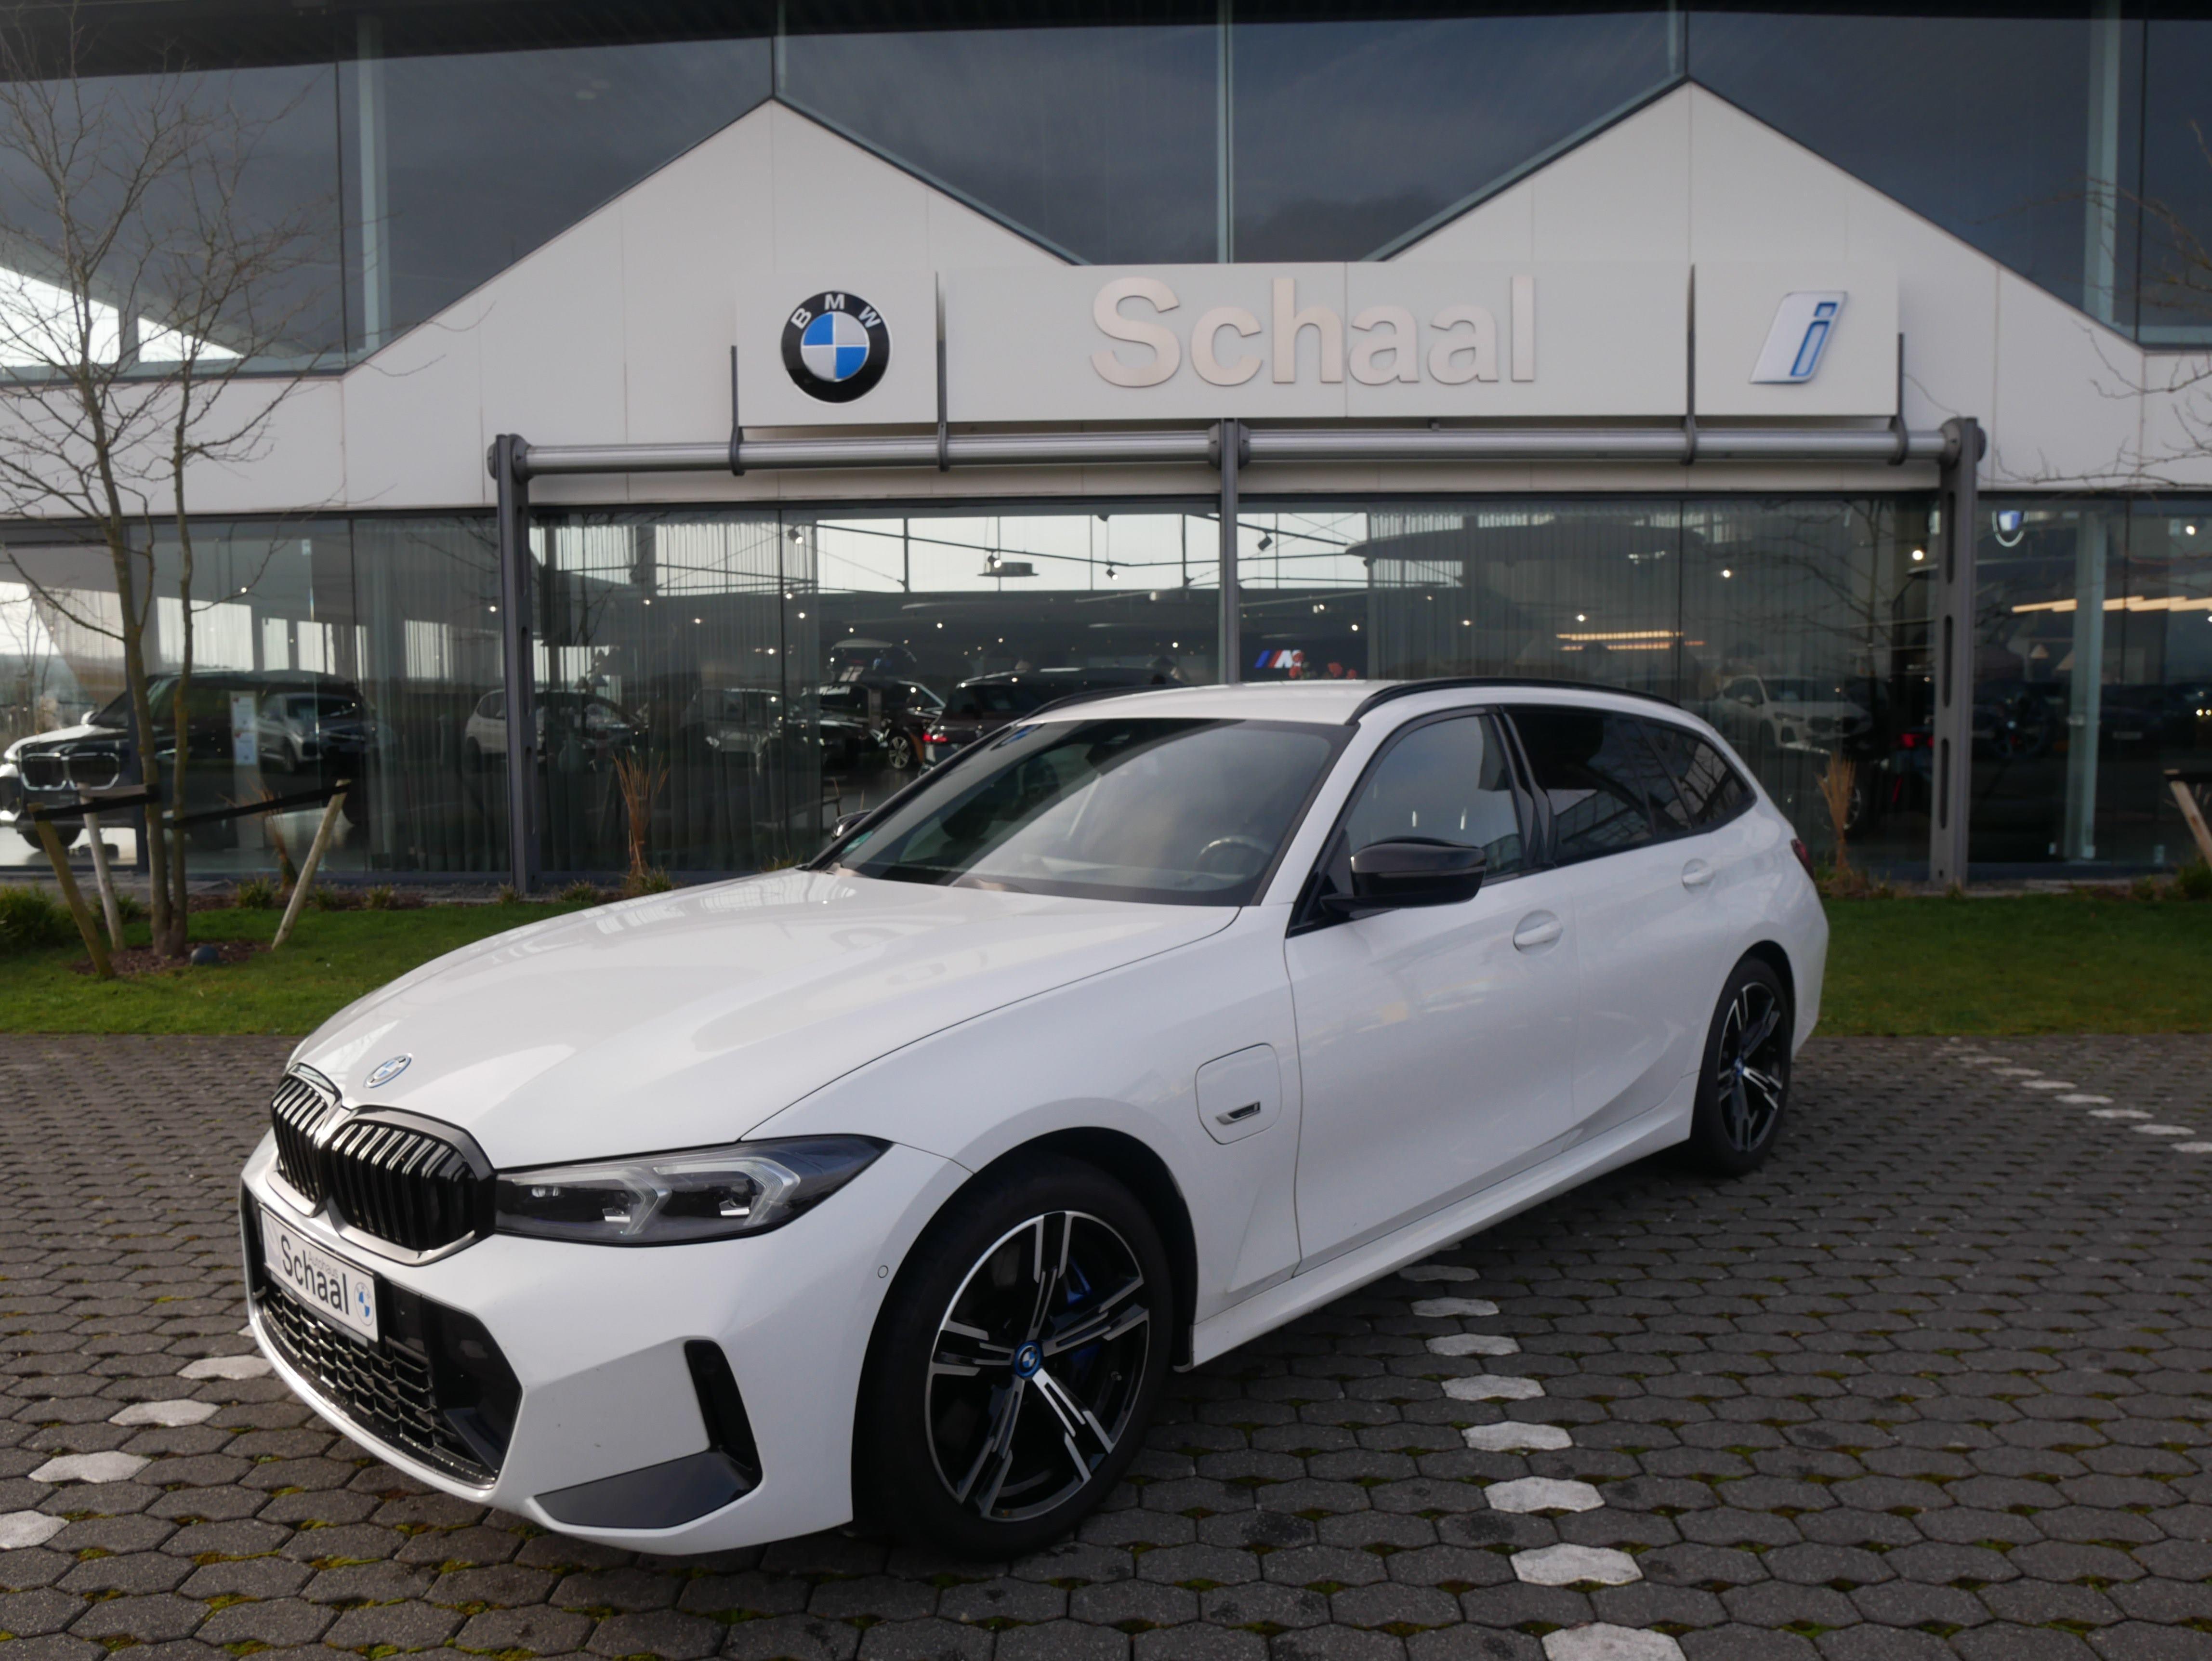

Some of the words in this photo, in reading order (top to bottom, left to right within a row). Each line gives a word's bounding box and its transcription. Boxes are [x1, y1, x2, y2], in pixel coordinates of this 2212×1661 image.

[790, 293, 881, 329] BMW
[1091, 276, 1535, 388] Schaal
[281, 1234, 350, 1316] Schaal
